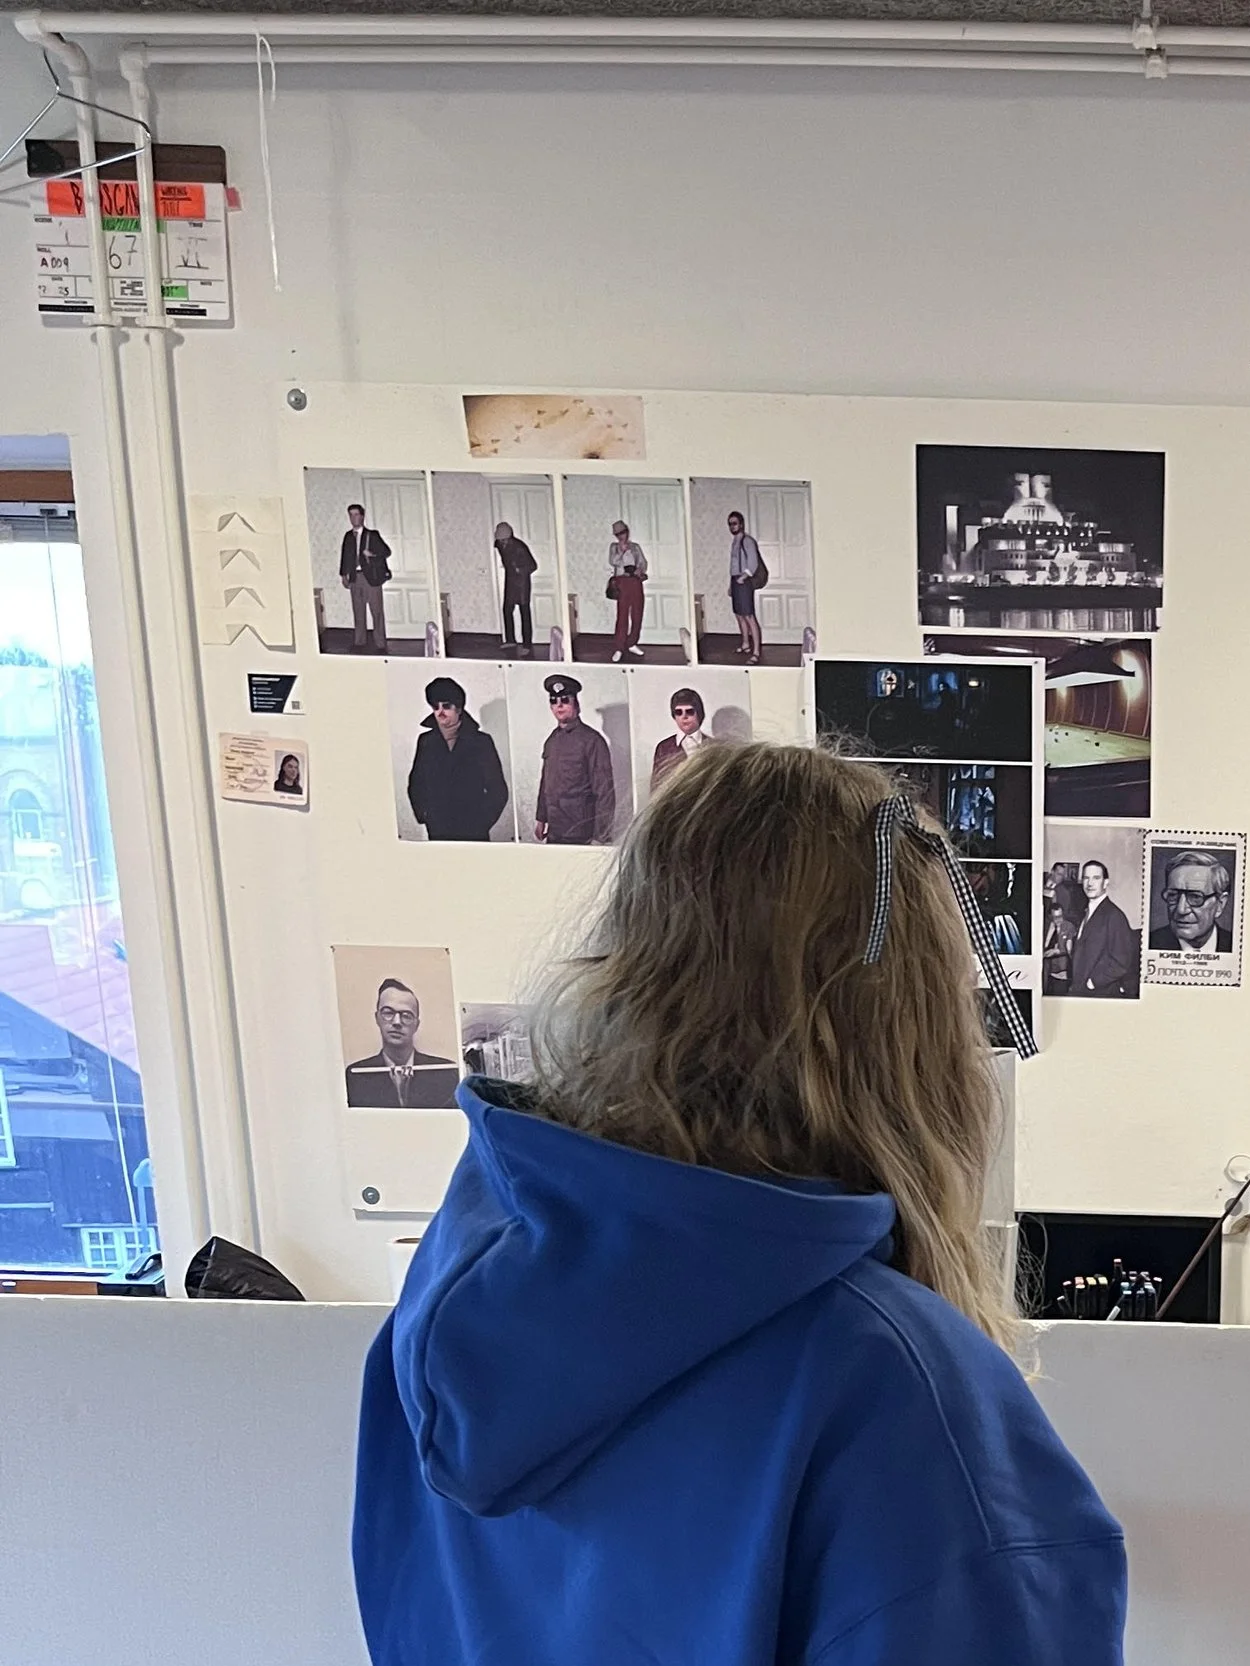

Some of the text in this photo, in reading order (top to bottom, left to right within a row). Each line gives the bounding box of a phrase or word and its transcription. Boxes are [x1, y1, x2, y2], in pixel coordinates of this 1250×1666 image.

[1159, 952, 1221, 961] КИМ ФИЛБИ
[1157, 967, 1188, 977] ПОЧТА
[1189, 968, 1214, 978] СССР
